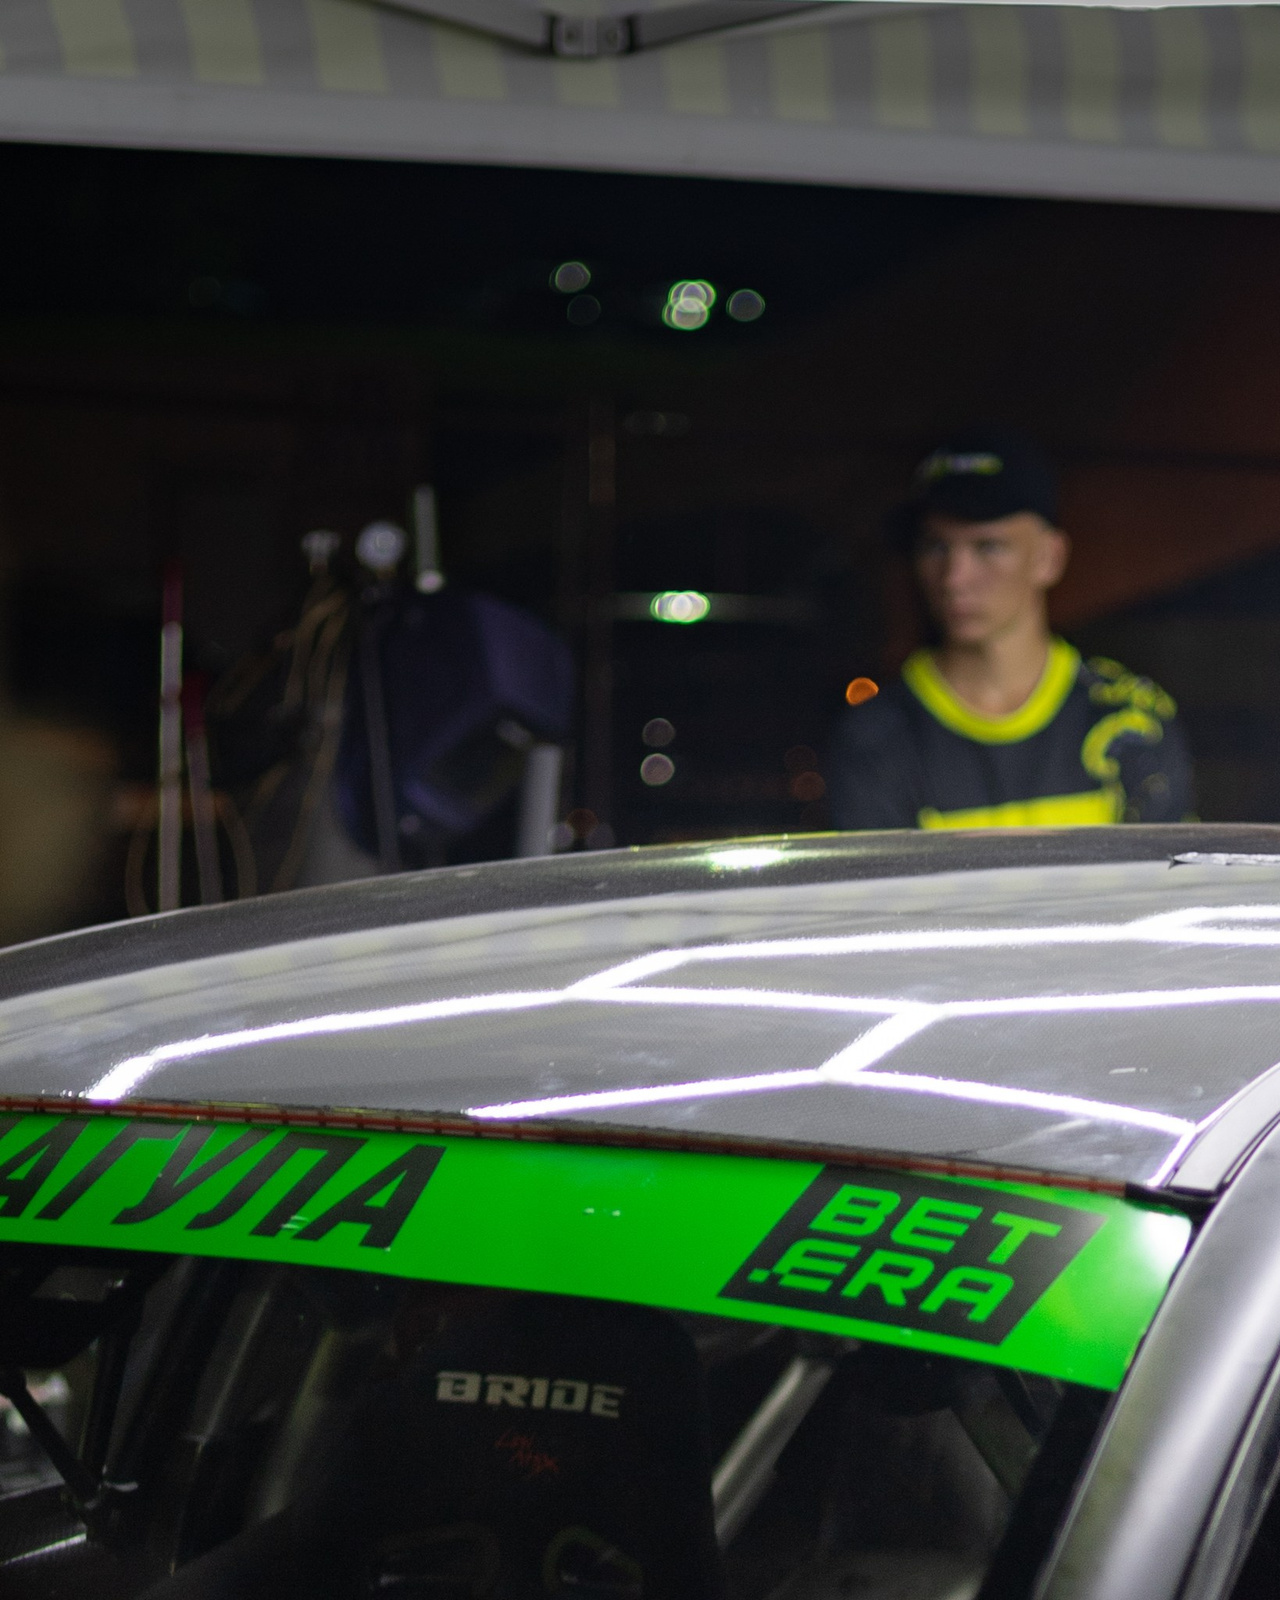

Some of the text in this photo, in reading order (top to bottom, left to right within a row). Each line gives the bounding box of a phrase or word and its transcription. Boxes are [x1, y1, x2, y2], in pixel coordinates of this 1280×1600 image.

[0, 1116, 447, 1249] АГУЛА
[808, 1183, 1063, 1265] BET
[436, 1370, 625, 1418] BRIDE
